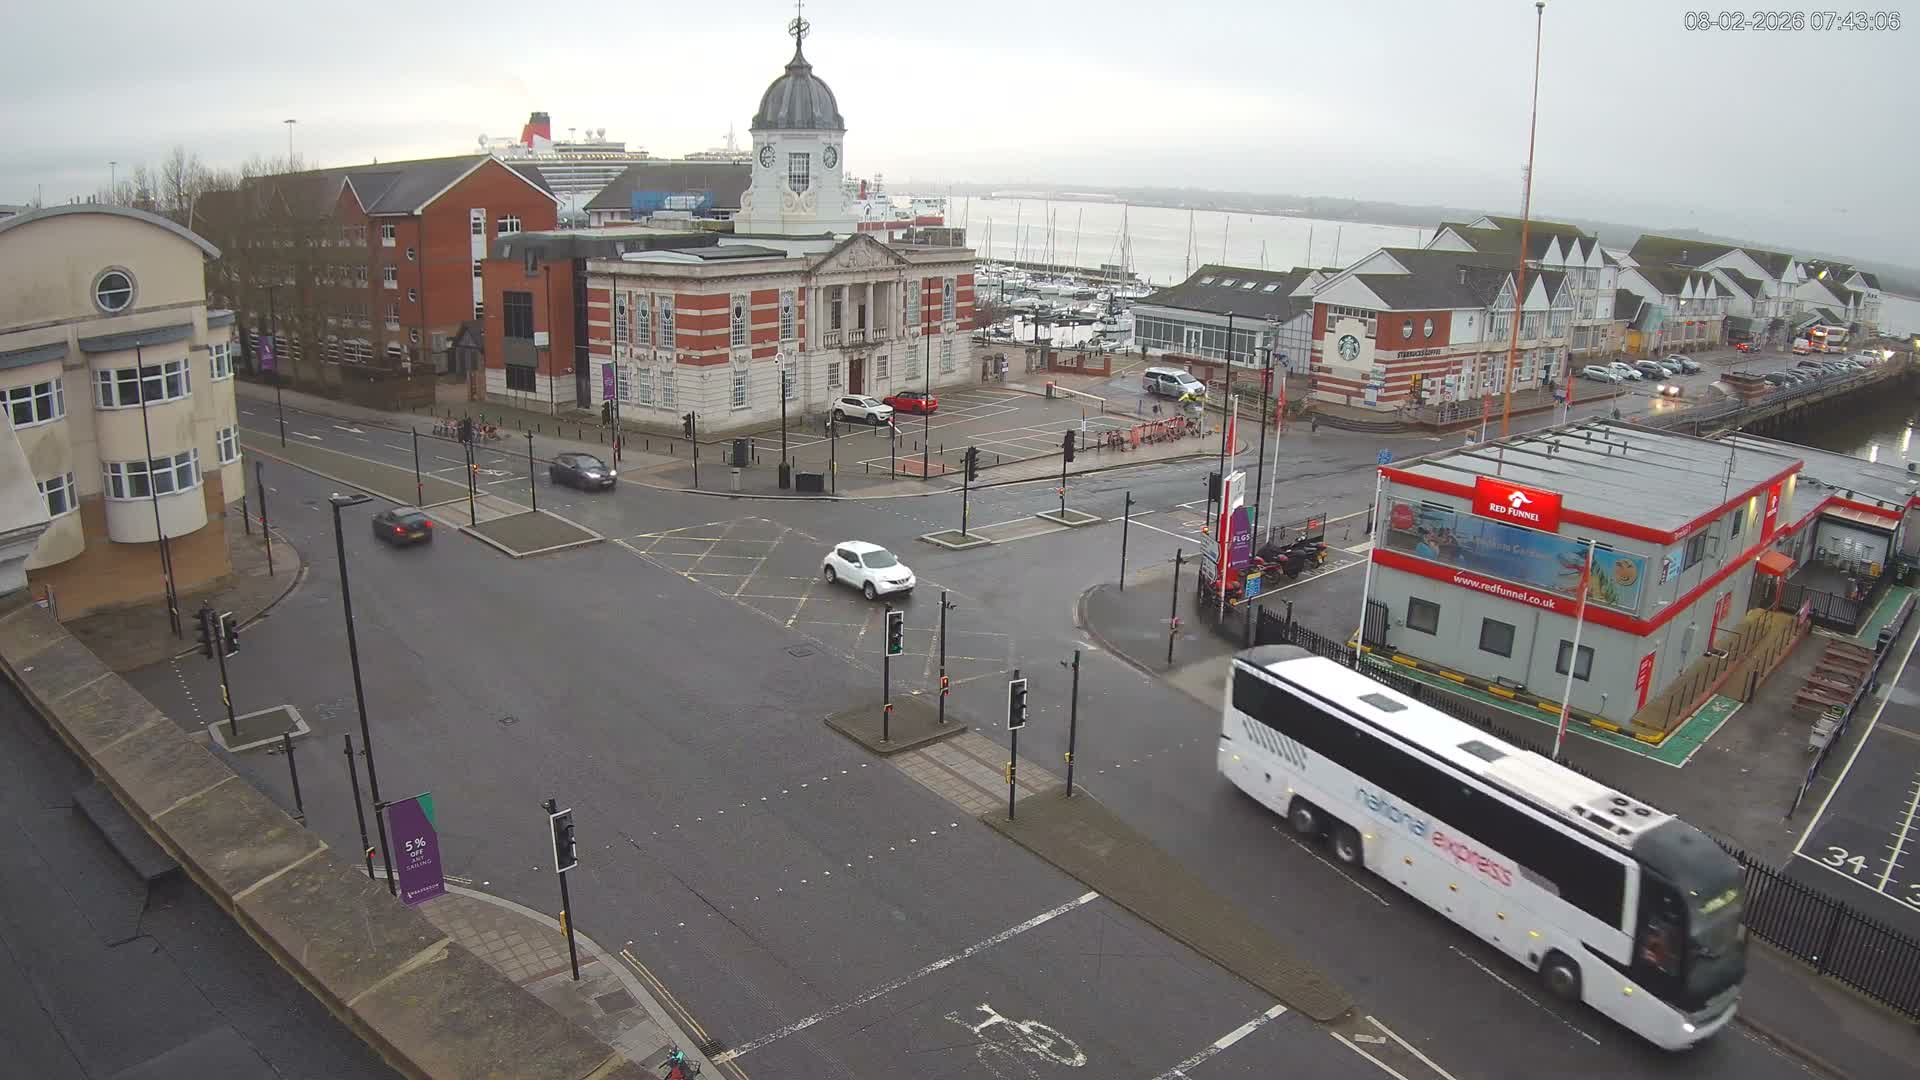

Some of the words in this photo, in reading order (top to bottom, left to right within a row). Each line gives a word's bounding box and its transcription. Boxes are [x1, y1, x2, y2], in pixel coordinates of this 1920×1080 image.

[1489, 502, 1506, 514] RED
[1507, 506, 1540, 522] FUNNEL
[1453, 574, 1556, 609] www.redfunnel.co.uk
[410, 848, 424, 858] OFF
[1821, 846, 1869, 875] 34
[406, 858, 432, 871] SAILING
[1905, 884, 1920, 906] 3
